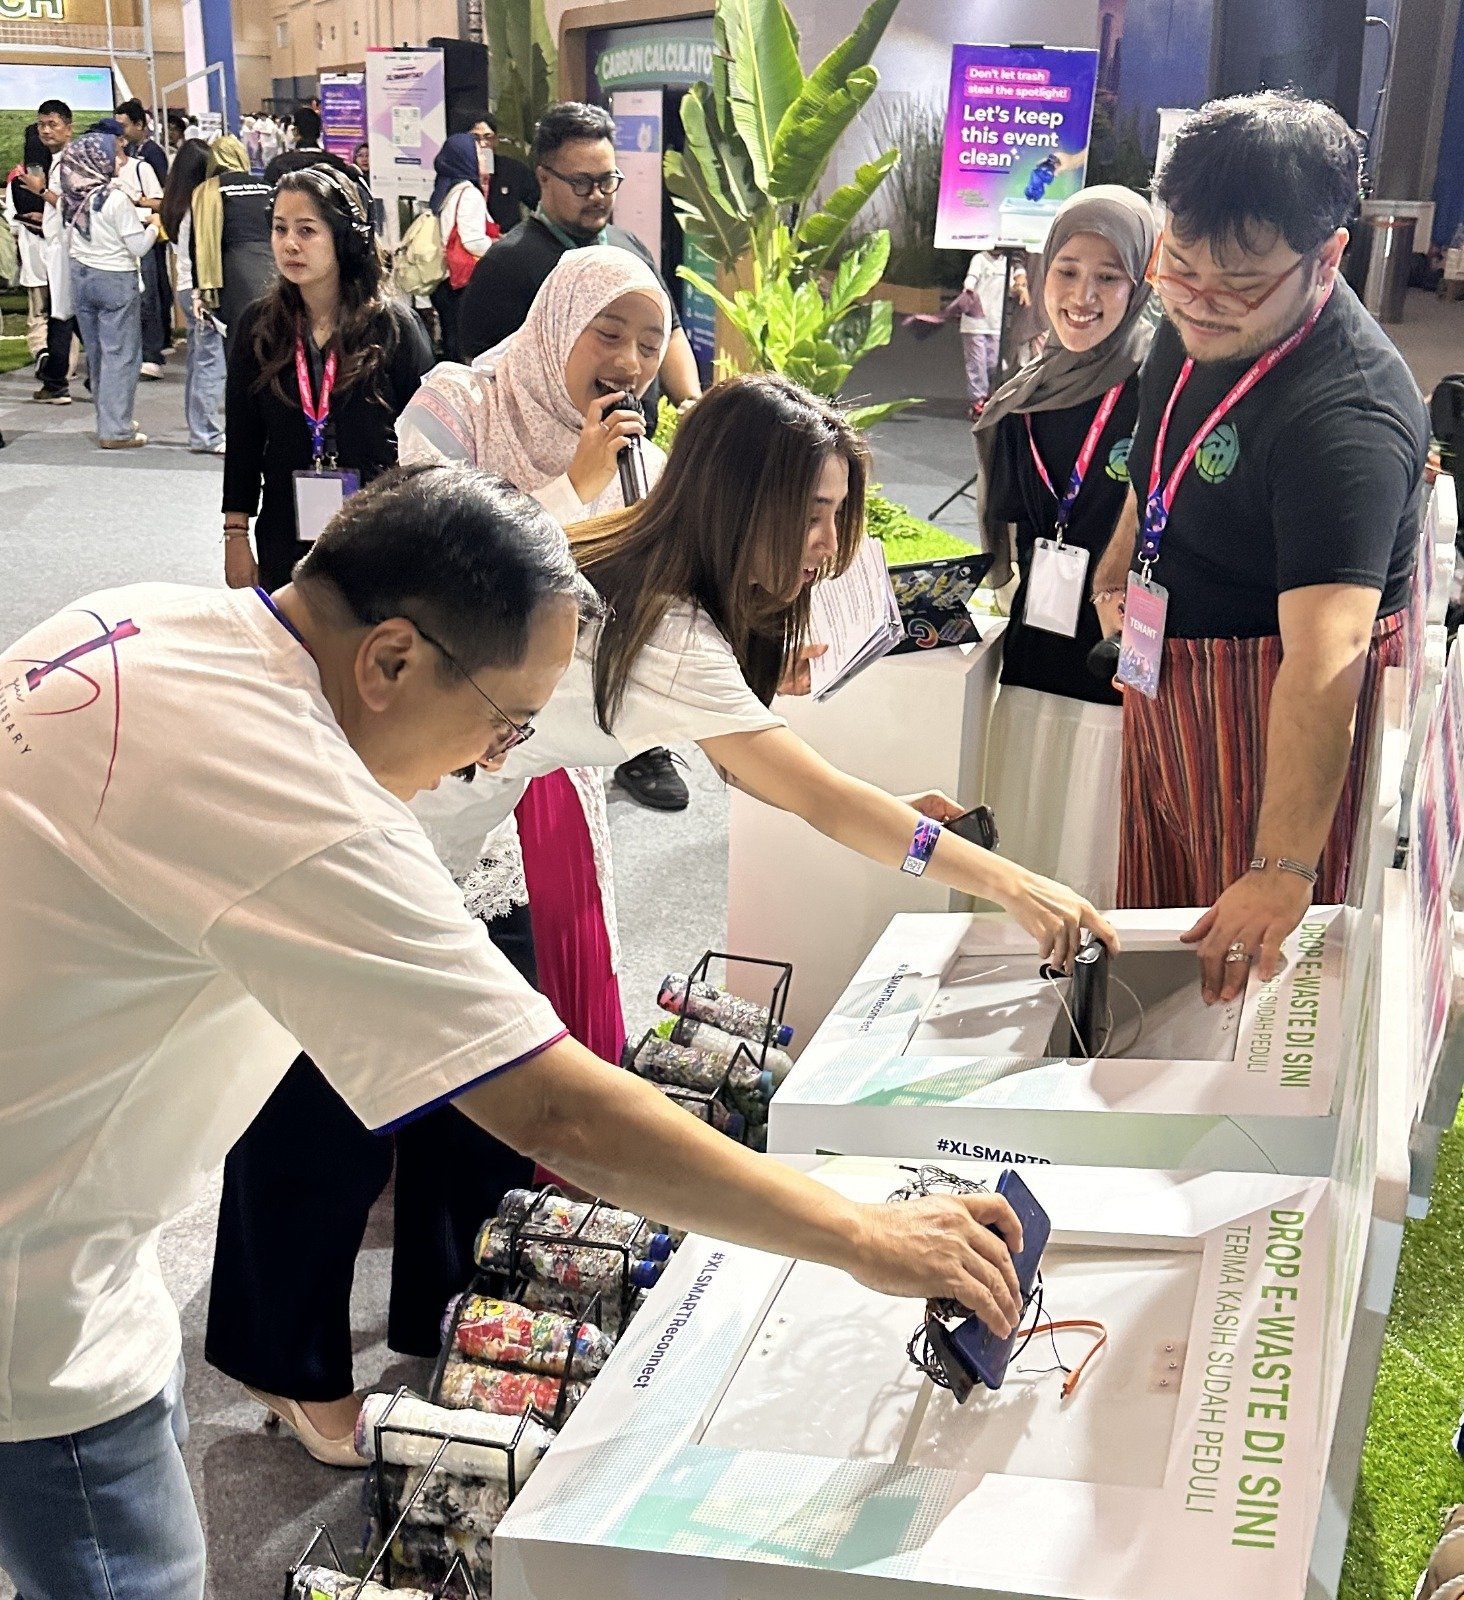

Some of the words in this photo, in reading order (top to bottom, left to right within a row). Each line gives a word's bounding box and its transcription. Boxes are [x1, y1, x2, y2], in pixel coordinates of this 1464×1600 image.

[601, 46, 643, 80] CARBON
[644, 43, 719, 75] CALCULATO
[969, 67, 999, 79] Don't
[1000, 69, 1015, 80] let
[1017, 70, 1045, 81] trash
[967, 84, 994, 95] steal
[995, 85, 1014, 96] the
[963, 104, 1010, 123] Let's
[1014, 106, 1064, 129] keep
[961, 125, 999, 144] this
[1002, 131, 1059, 147] event
[959, 147, 1012, 166] clean
[1129, 616, 1158, 640] TENANT
[1298, 923, 1327, 958] DROP
[1253, 994, 1279, 1031] SUDAH
[1288, 961, 1323, 1028] E-WASTE
[1247, 1033, 1272, 1073] PEDULI
[1285, 1032, 1316, 1048] DI
[1280, 1052, 1314, 1088] SINI
[1218, 1224, 1252, 1286] TERIMA
[1264, 1209, 1306, 1278] DROP
[633, 1252, 726, 1389] #XLSMARTReconnect
[1209, 1289, 1243, 1345] KASIH
[1247, 1284, 1298, 1421] E-WASTE
[1197, 1350, 1235, 1424] SUDAH
[1242, 1429, 1286, 1464] DI
[1185, 1429, 1224, 1513] PEDULI
[1231, 1474, 1282, 1549] SINI
